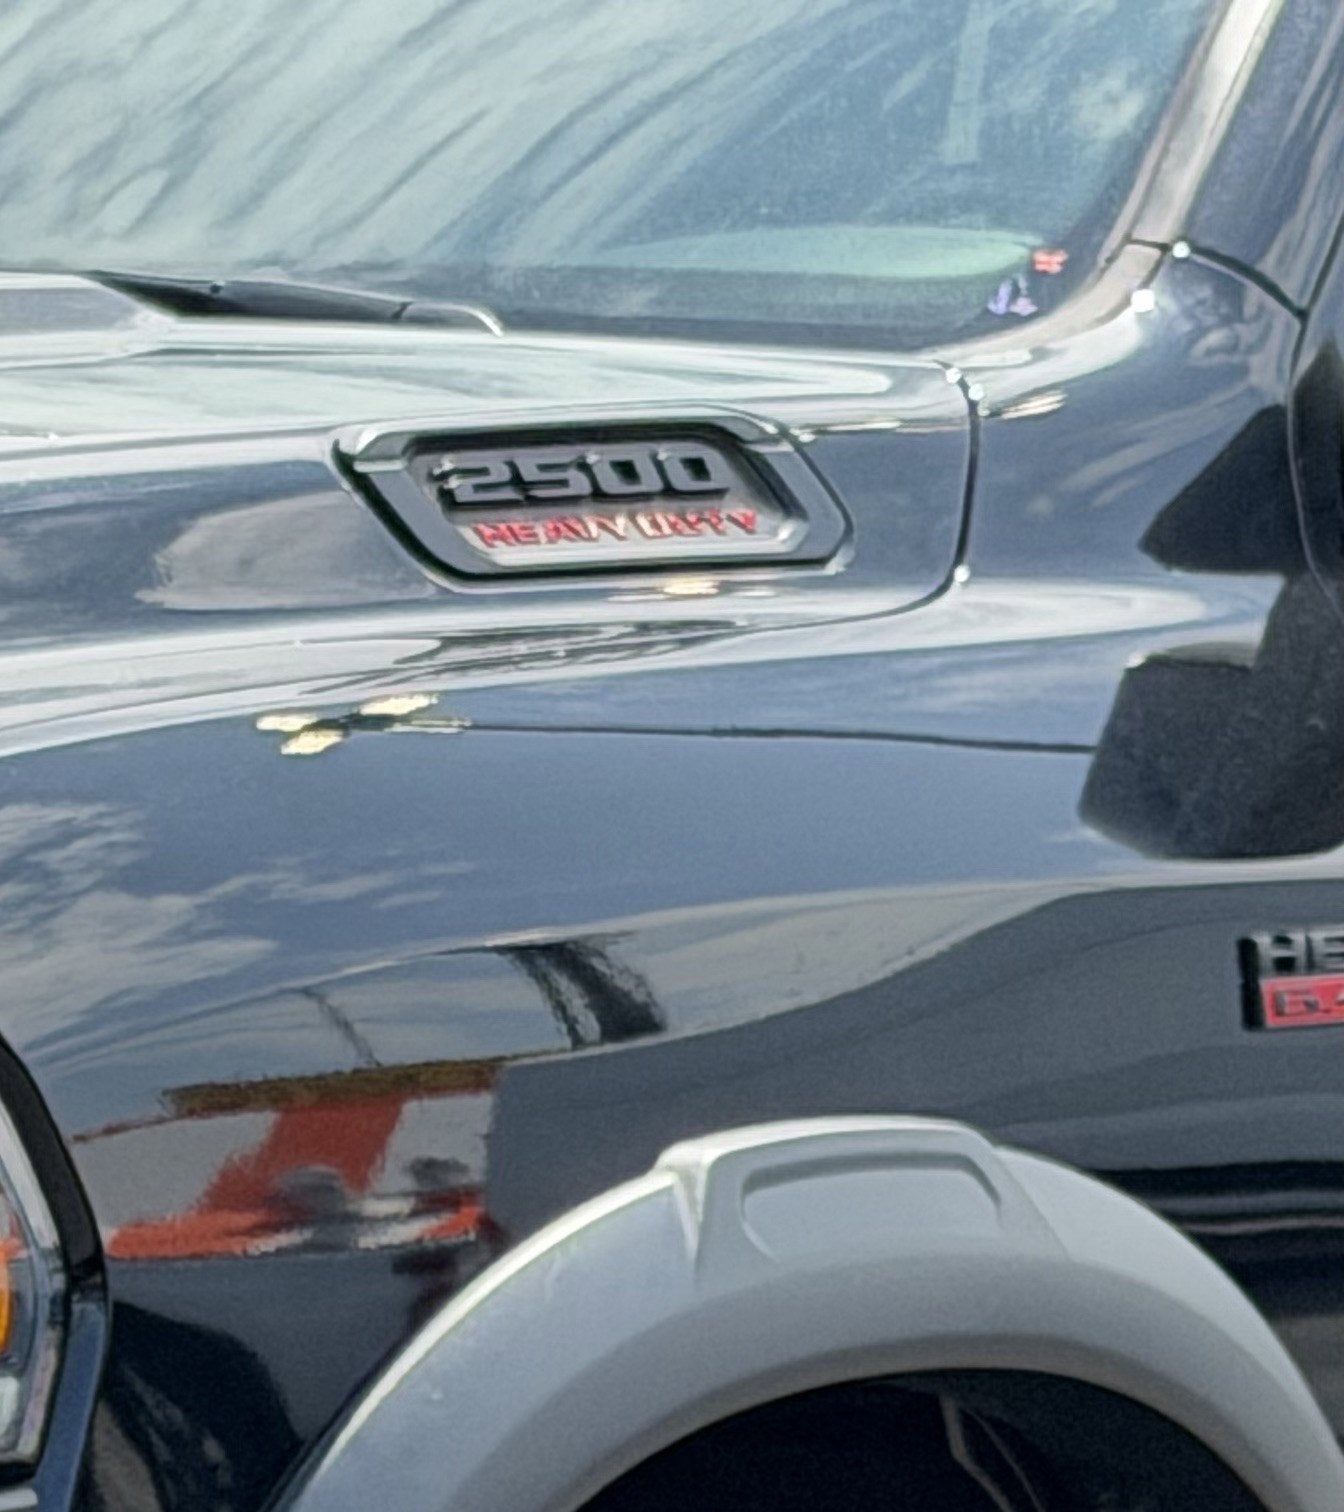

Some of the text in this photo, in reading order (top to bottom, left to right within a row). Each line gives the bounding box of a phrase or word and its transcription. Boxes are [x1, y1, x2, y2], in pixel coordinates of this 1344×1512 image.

[433, 444, 731, 504] 2500
[473, 507, 758, 548] HEAVY DUTY
